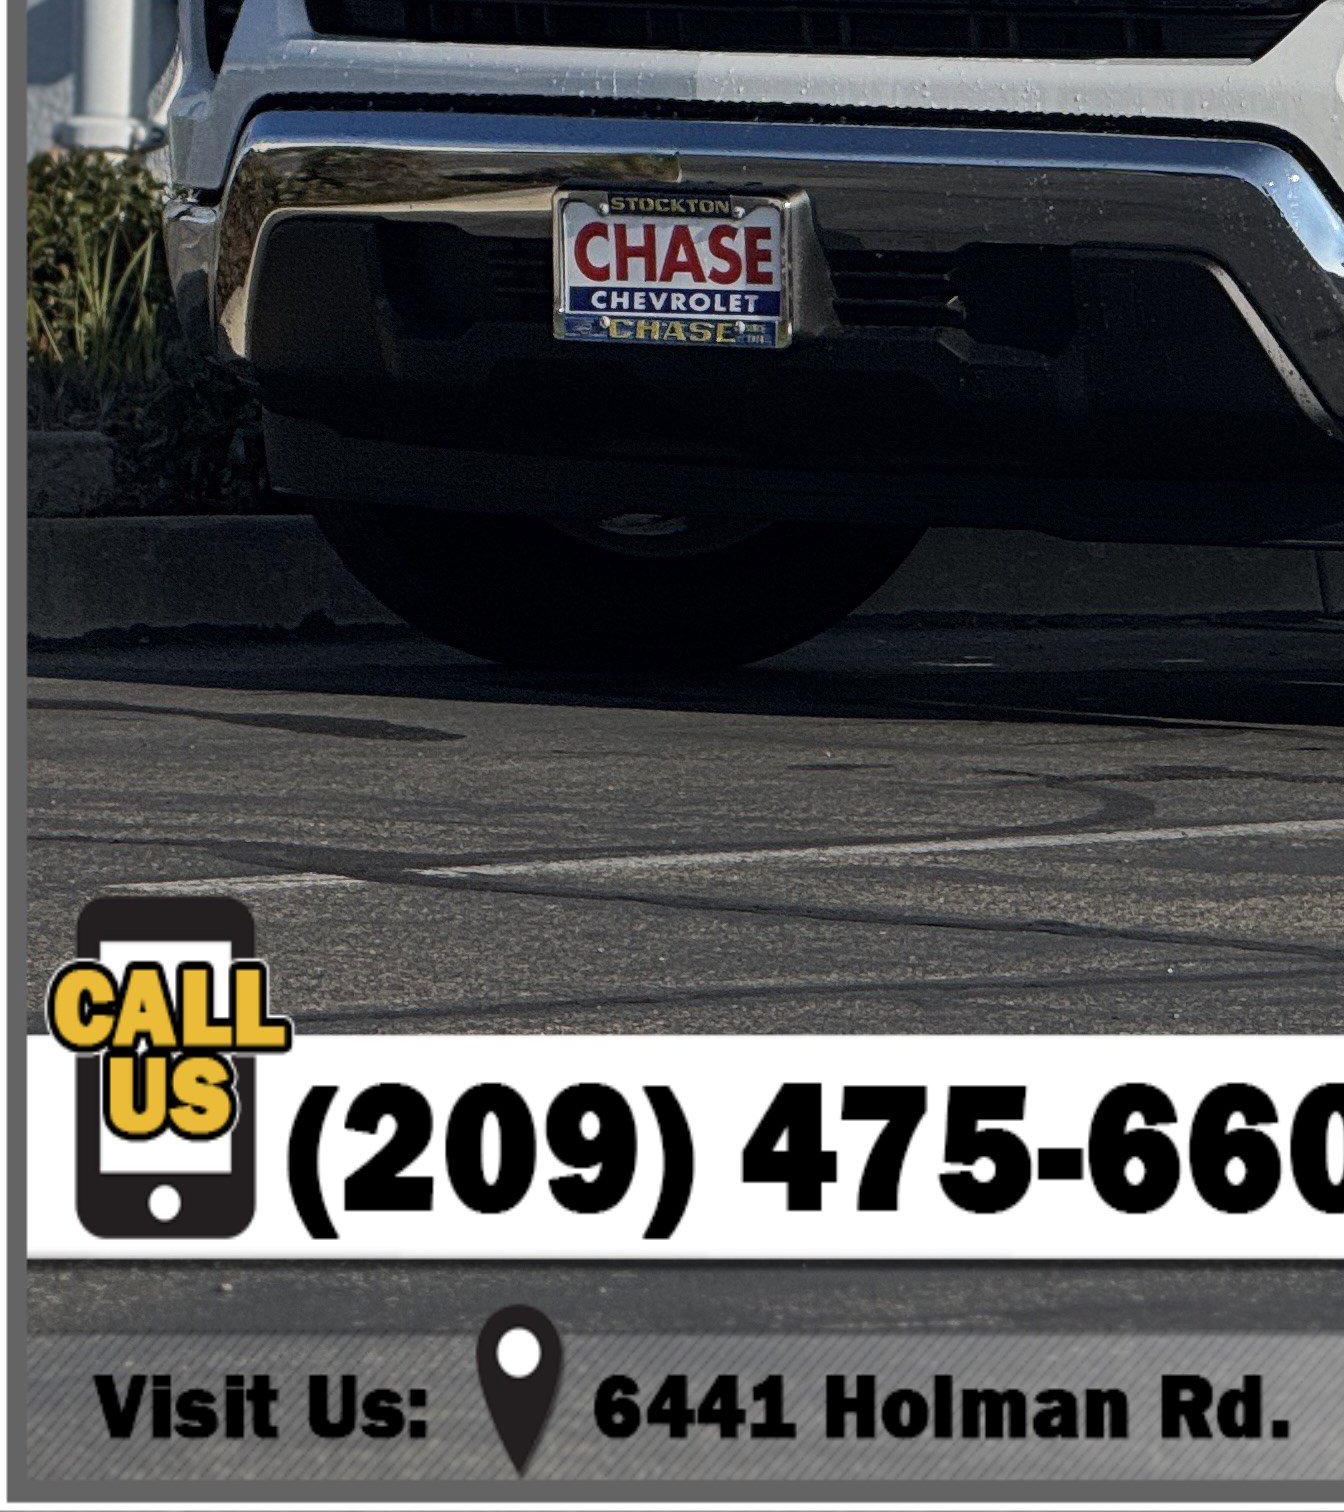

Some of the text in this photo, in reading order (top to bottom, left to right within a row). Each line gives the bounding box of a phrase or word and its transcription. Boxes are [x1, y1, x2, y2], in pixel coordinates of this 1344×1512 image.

[610, 197, 731, 214] STOCKTON
[573, 221, 774, 285] CHASE
[590, 290, 760, 313] CHEVROLET
[608, 318, 737, 344] CHASE
